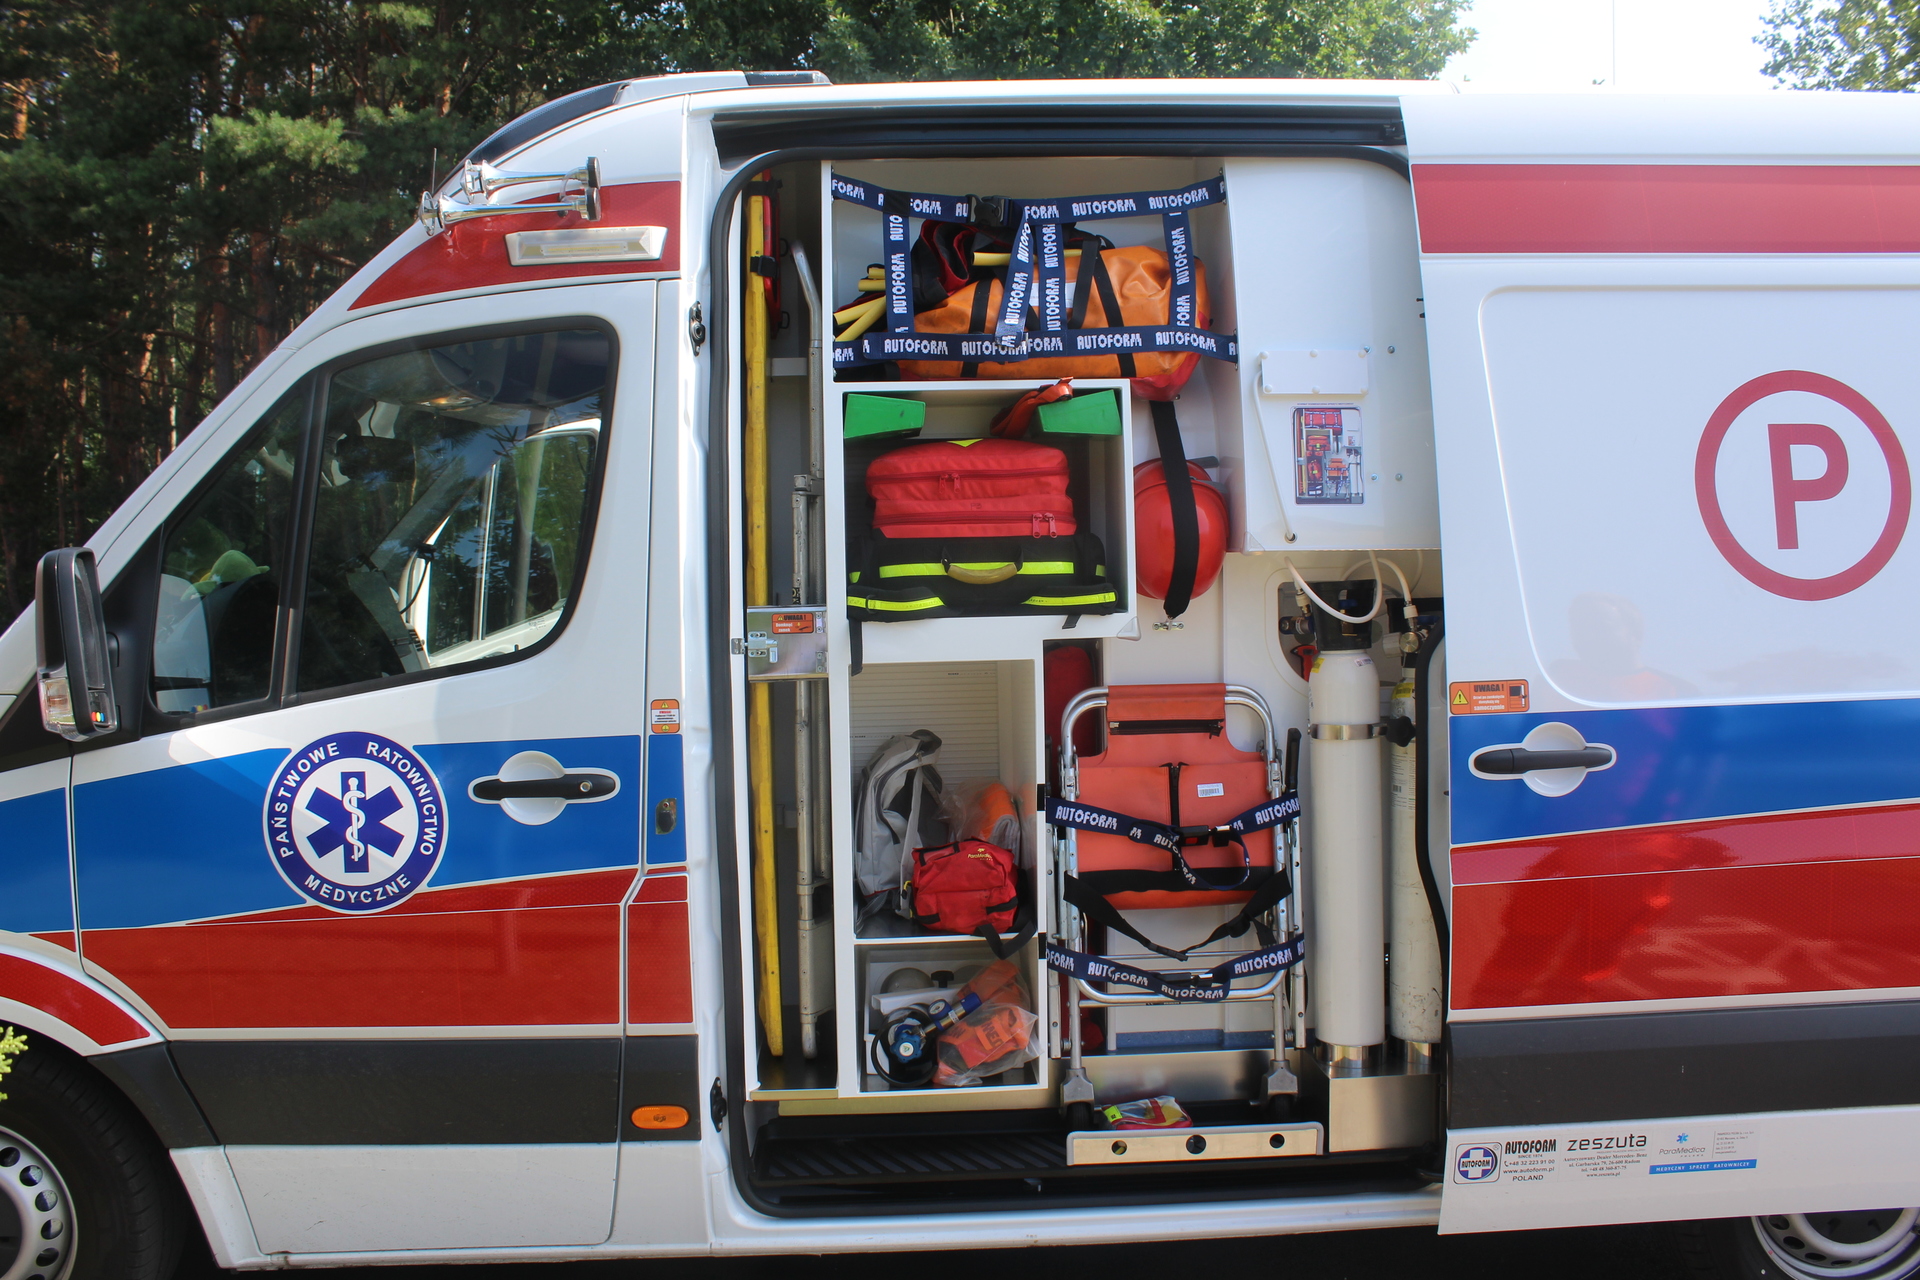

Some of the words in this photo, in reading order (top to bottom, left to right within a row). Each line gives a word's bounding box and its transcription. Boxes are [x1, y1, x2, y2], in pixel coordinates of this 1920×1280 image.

[1072, 198, 1137, 217] AUTOFORM
[1148, 187, 1209, 210] AUTOFORM
[1171, 226, 1190, 286] AUTOFORM
[891, 253, 905, 314] AUTOFORM
[1004, 271, 1029, 326] AUTOFORM
[884, 339, 949, 356] AUTOFORM
[1077, 333, 1142, 351] AUTOFORM
[1156, 331, 1217, 352] AUTOFORM
[1767, 423, 1849, 550] P
[1474, 684, 1500, 692] UWAGA
[271, 742, 340, 858] PAŃSTWOWE
[366, 741, 438, 856] RATOWNICTWO
[1055, 805, 1118, 830] AUTOFORM
[304, 874, 411, 904] MEDYCZNE
[1234, 948, 1293, 975] AUTOFORM
[1161, 984, 1223, 999] AUTOFORM
[1505, 1138, 1557, 1154] AUTOFORM
[1567, 1133, 1647, 1152] zeszuta
[1659, 1146, 1706, 1155] ParaMedica
[1461, 1159, 1491, 1169] AUTOFORM
[1512, 1174, 1544, 1182] POLAND
